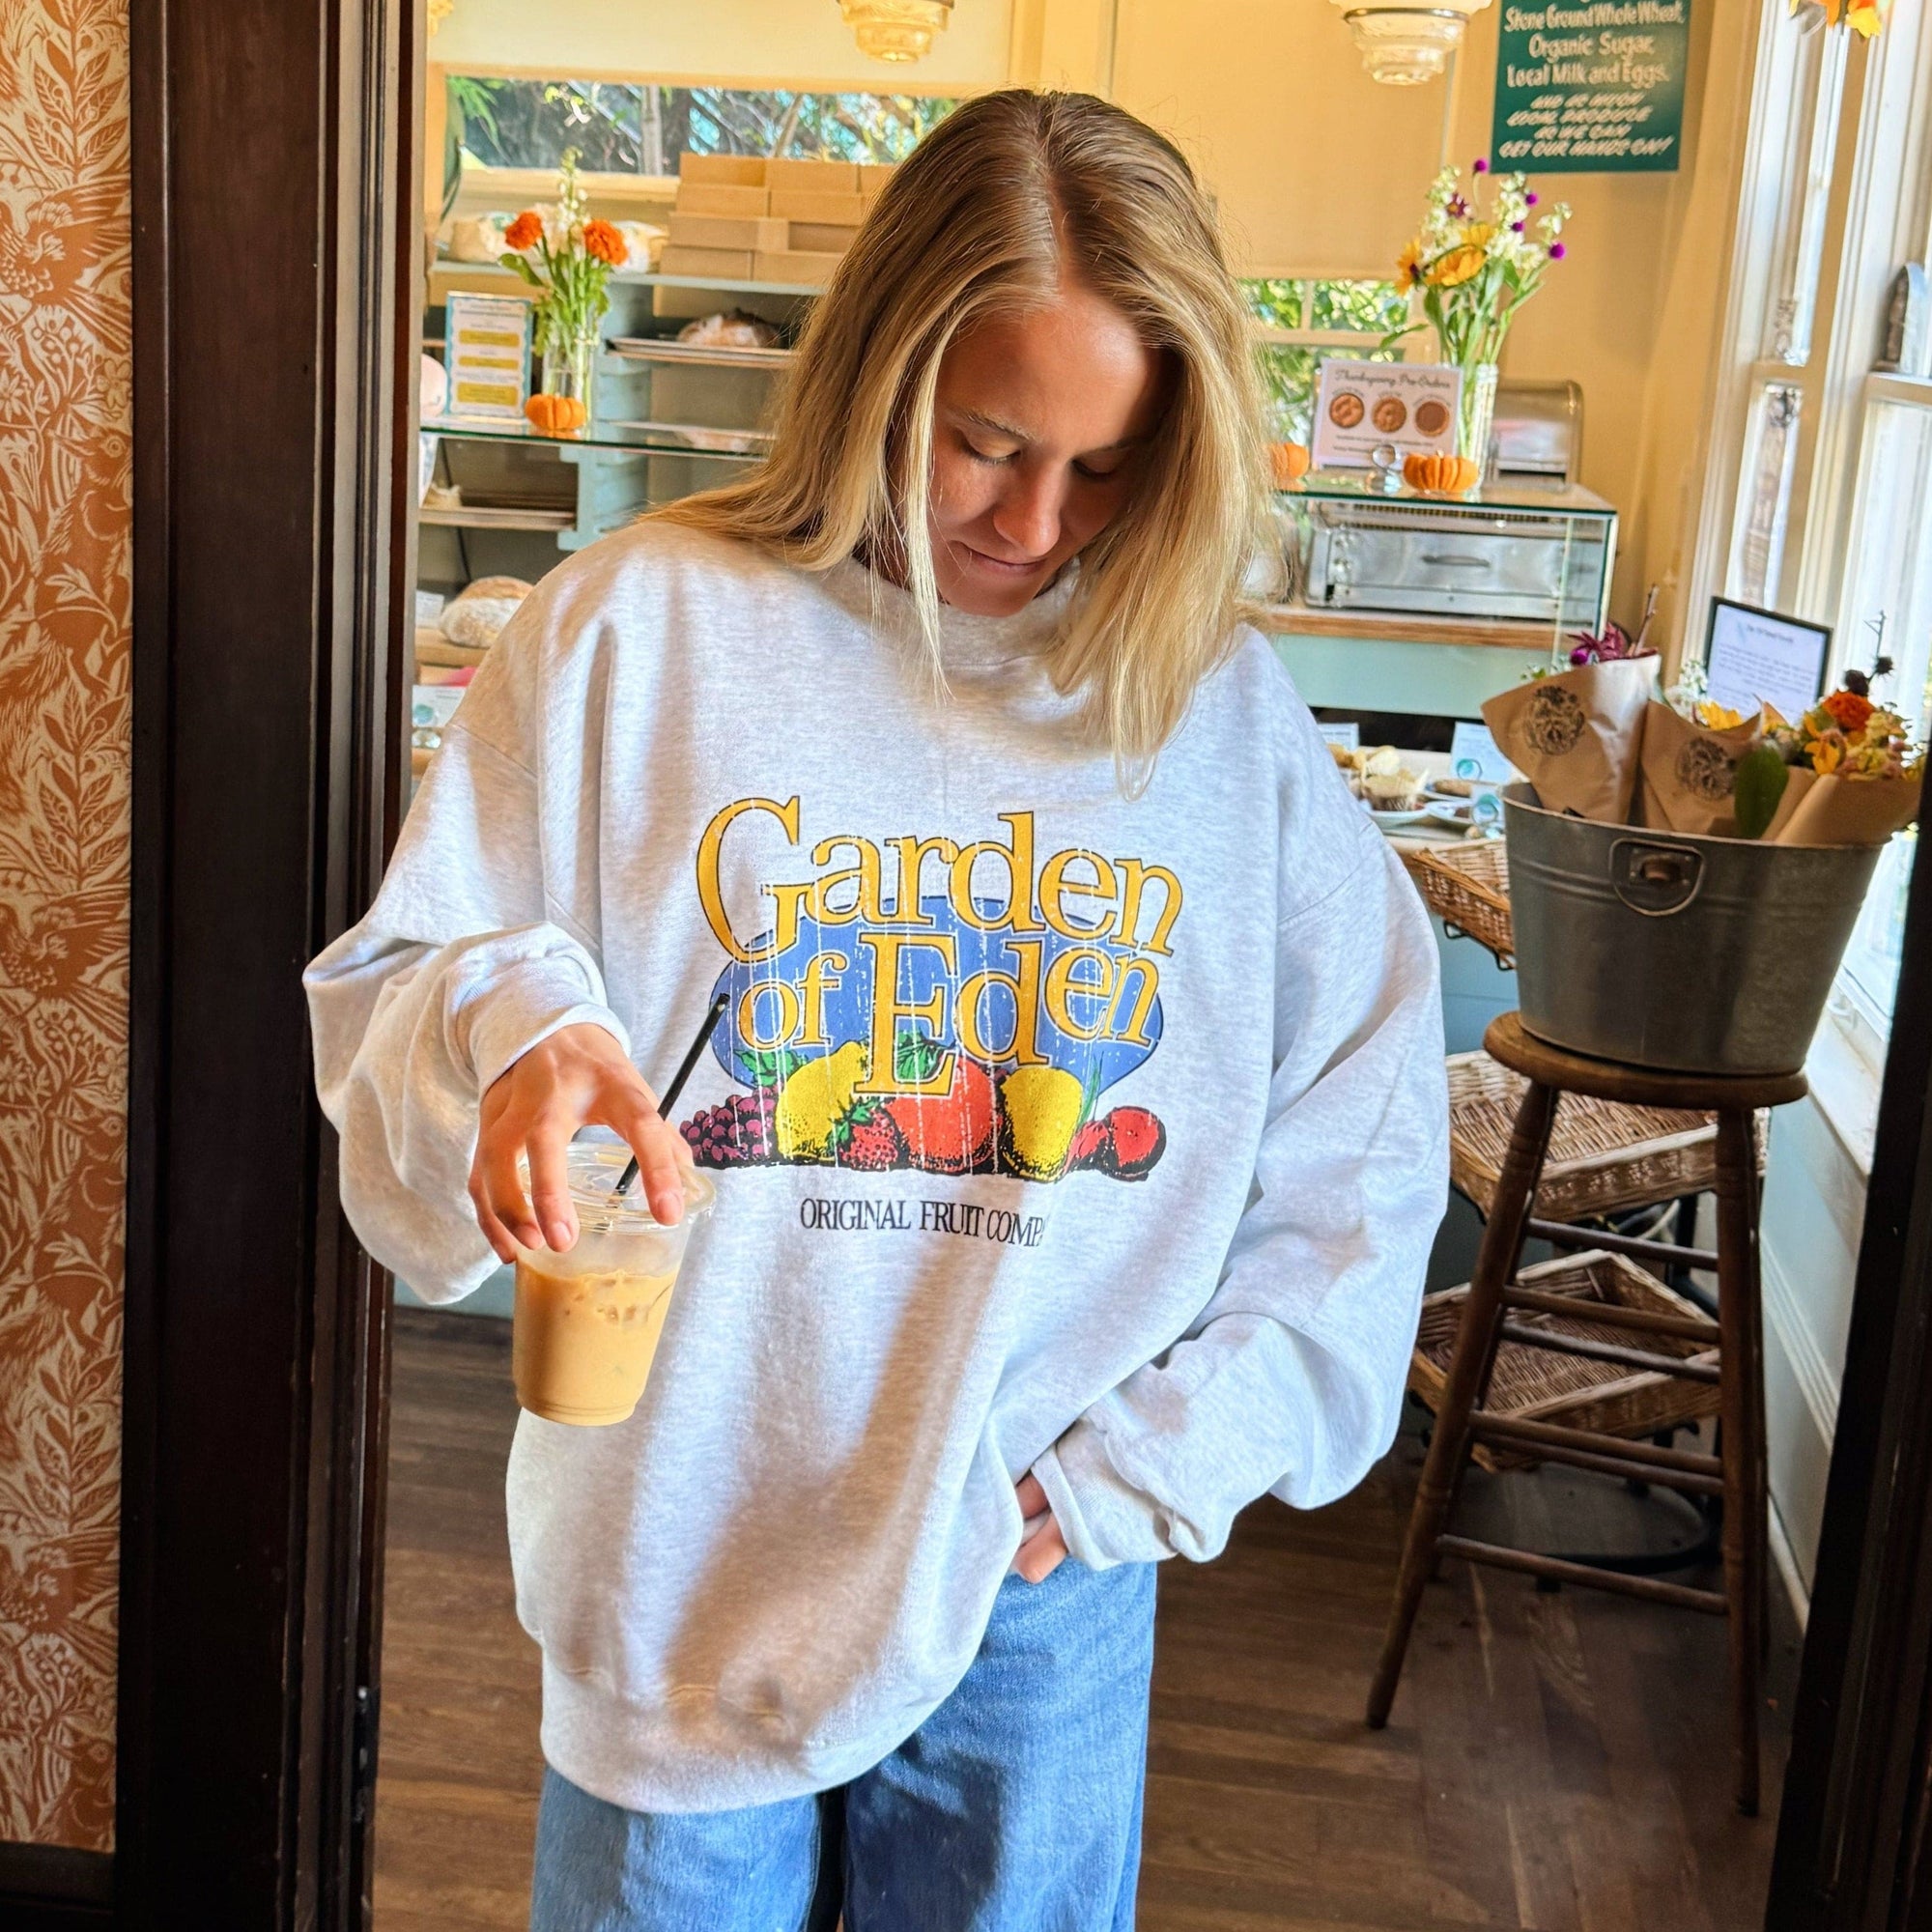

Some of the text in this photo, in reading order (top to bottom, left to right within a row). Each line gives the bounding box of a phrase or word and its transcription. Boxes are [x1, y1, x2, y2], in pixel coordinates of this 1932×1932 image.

[1505, 6, 1545, 32] Stone
[1547, 4, 1594, 29] Ground
[1595, 2, 1637, 26] Whole
[1529, 32, 1594, 64] Organic
[1507, 64, 1550, 88] Local
[1551, 63, 1587, 85] Milk
[1588, 61, 1620, 84] and
[696, 796, 1184, 964] Garden
[738, 930, 1162, 1098] of Eden
[800, 1198, 1043, 1247] ORIGINAL FRUIT COMP
